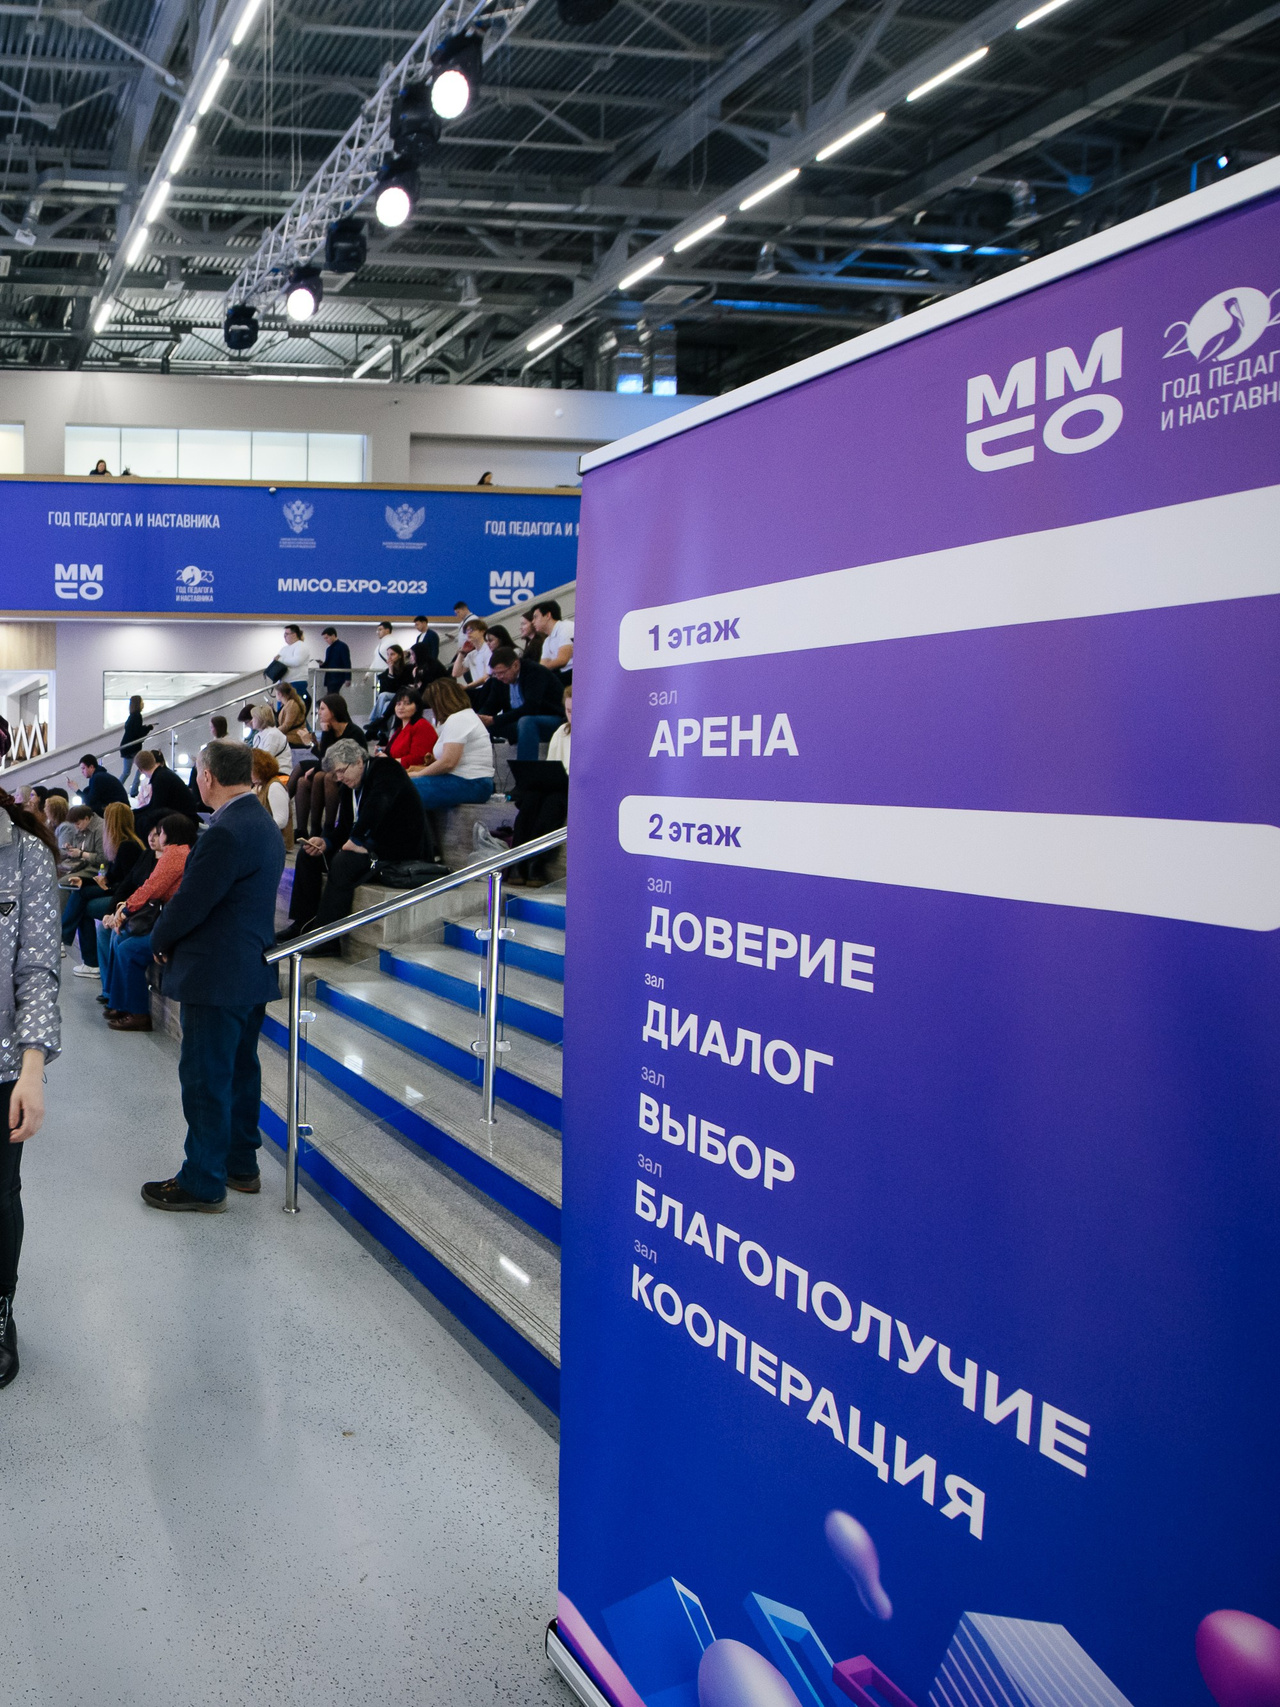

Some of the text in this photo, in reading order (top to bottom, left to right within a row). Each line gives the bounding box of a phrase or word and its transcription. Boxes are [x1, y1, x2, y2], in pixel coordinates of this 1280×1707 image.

[1162, 373, 1201, 402] ГОД
[1161, 381, 1280, 431] И НАСТАВН
[48, 511, 220, 529] ГОД ПЕДАГОГА И НАСТАВНИКА
[485, 520, 506, 537] ГОД
[509, 521, 563, 537] ПЕДАГОГА
[564, 522, 573, 537] И
[648, 617, 741, 651] 1 этаж
[649, 690, 678, 706] зал
[649, 713, 799, 758] АРЕНА
[648, 814, 742, 848] 2 этаж
[646, 877, 672, 895] зал
[645, 906, 876, 993] ДОВЕРИЕ
[644, 972, 665, 990] зал
[642, 1000, 834, 1094] ДИАЛОГ
[641, 1066, 665, 1089] зал
[638, 1092, 795, 1191] ВЫБОР
[637, 1153, 662, 1178] зал
[633, 1239, 657, 1265] зал
[635, 1179, 1091, 1478] БЛАГОПОЛУЧИЕ
[631, 1264, 986, 1541] КООПЕРАЦИЯ
